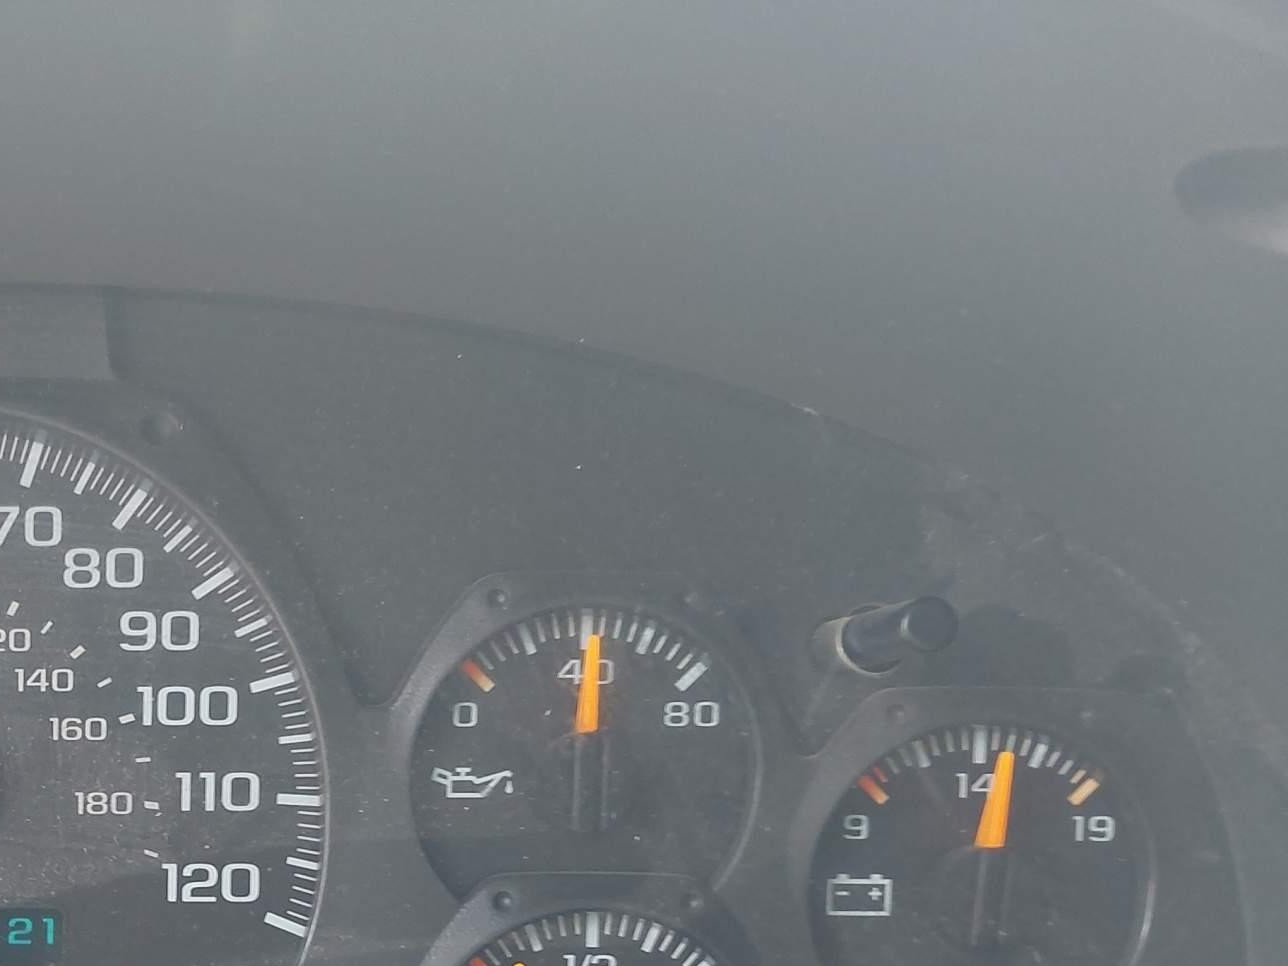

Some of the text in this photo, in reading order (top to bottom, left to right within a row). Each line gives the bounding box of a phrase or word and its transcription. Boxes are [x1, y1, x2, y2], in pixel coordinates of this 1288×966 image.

[63, 548, 144, 589] 80
[119, 611, 199, 651] 90
[15, 669, 74, 692] 140
[557, 659, 614, 685] 40
[136, 686, 238, 726] 100
[452, 702, 478, 728] 0
[663, 701, 720, 728] 80
[49, 717, 108, 741] 160
[75, 792, 134, 816] 180
[175, 772, 260, 812] 110
[843, 815, 869, 841] 9
[1072, 815, 1116, 842] 19
[161, 863, 260, 903] 120
